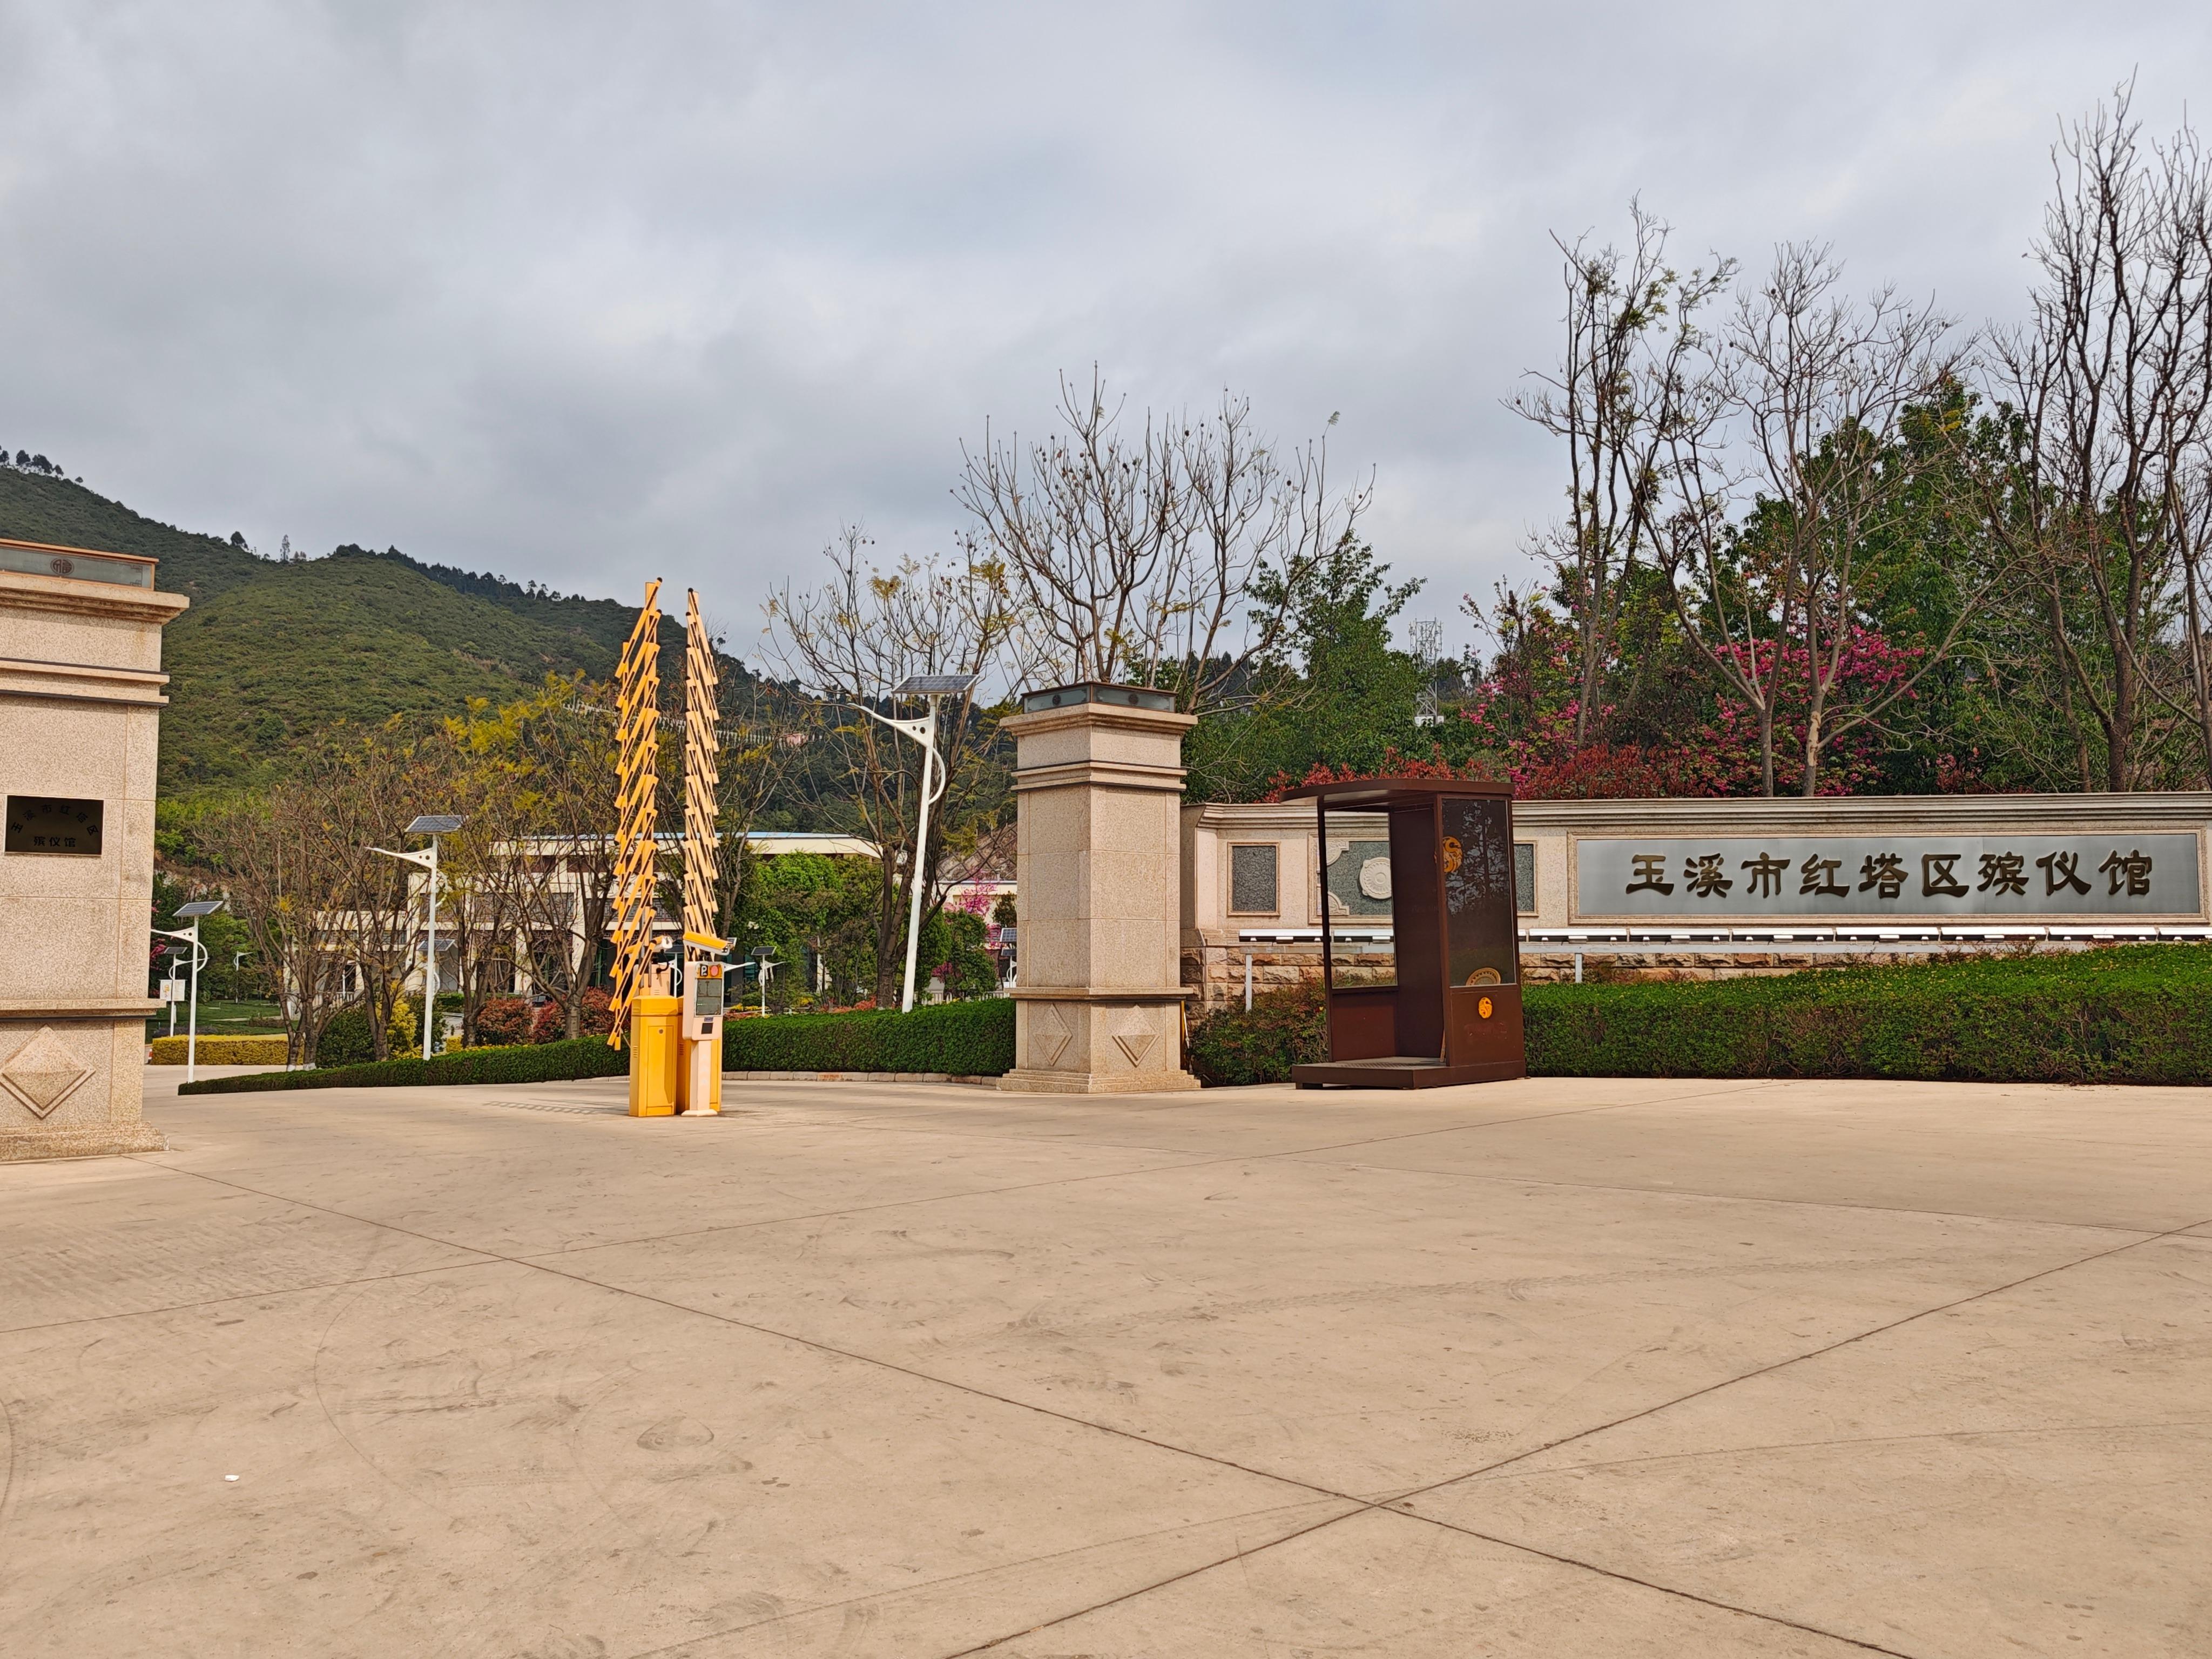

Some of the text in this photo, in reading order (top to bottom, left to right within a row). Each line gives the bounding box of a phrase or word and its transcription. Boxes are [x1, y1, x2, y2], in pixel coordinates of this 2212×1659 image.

[34, 836, 76, 847] 殡仪馆
[1626, 849, 2153, 899] 玉溪市红塔区殡仪馆
